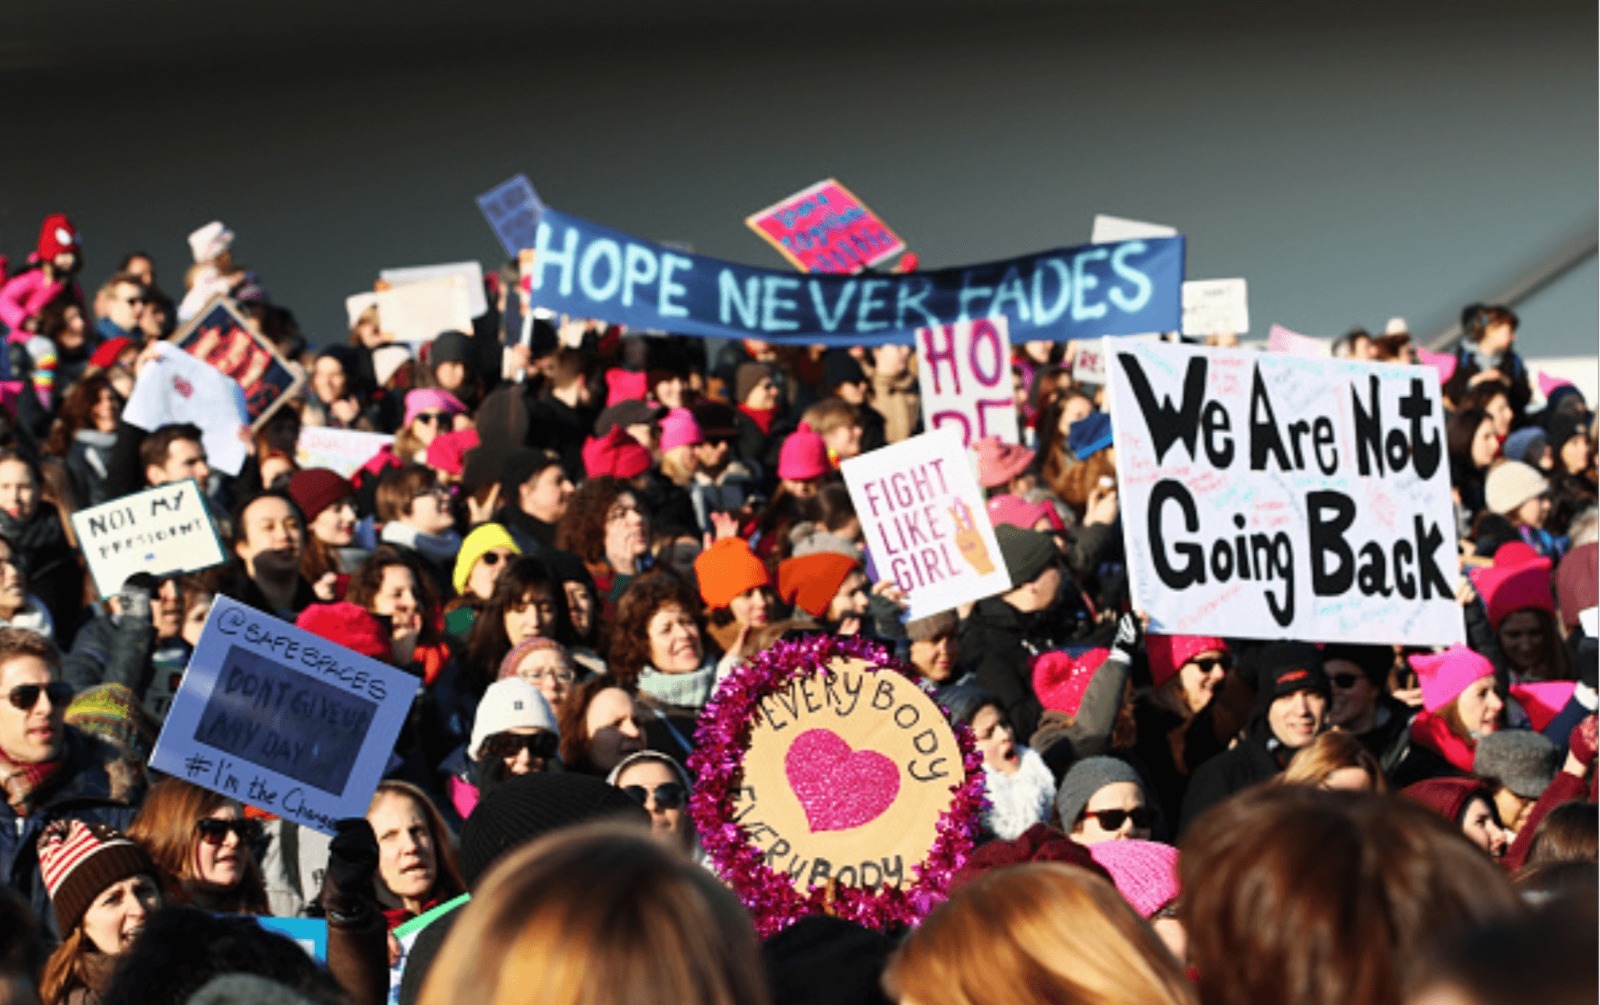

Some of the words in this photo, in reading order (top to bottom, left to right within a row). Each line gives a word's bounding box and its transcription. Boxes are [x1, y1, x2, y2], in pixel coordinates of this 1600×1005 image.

[531, 221, 693, 318] HOPE
[718, 268, 942, 334] NEVER
[958, 239, 1152, 326] FADES
[920, 318, 1003, 395] HO
[1116, 351, 1235, 470] We
[1249, 358, 1339, 476] Are
[1351, 373, 1443, 481] Not
[151, 490, 184, 516] MY
[863, 457, 949, 517] FIGHT
[877, 504, 946, 556] LIKE
[1147, 477, 1295, 627] Going
[1306, 489, 1456, 602] Back
[890, 543, 962, 593] GIRL
[249, 774, 279, 804] the
